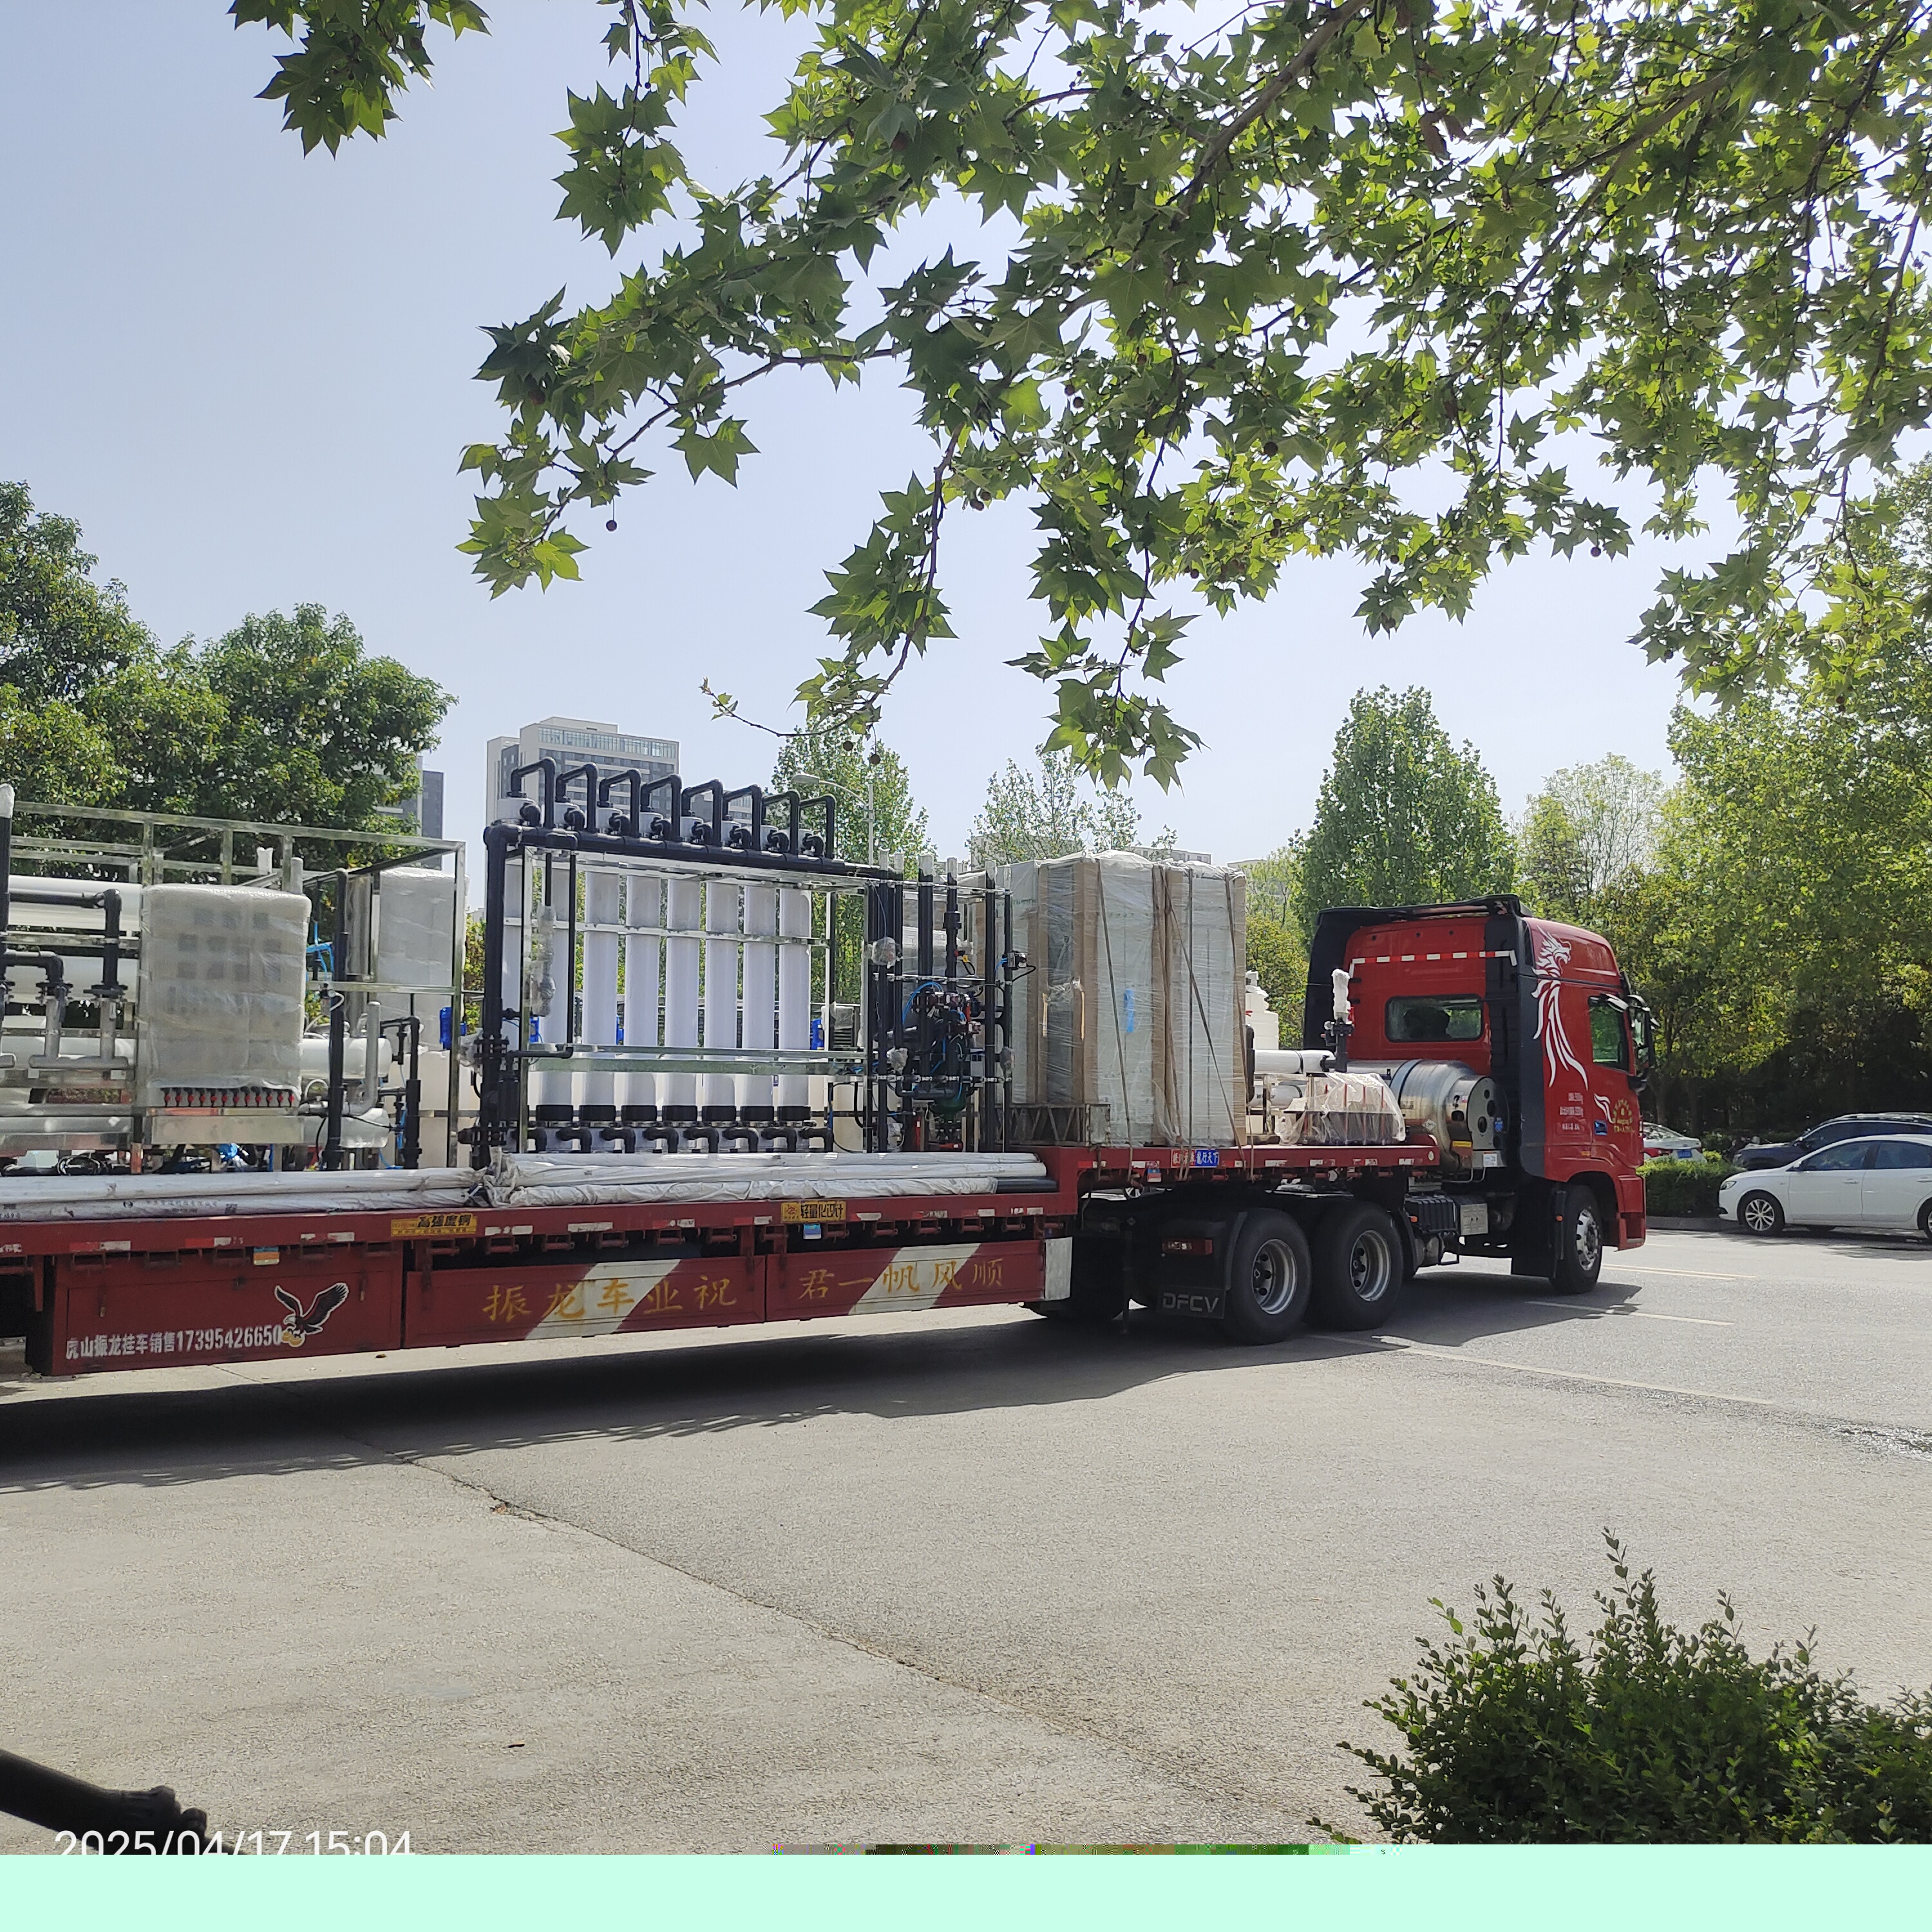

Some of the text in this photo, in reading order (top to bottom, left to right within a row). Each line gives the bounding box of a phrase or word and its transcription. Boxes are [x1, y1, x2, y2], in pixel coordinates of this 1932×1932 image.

[800, 1202, 844, 1220] 轻量化设计
[482, 1258, 1003, 1323] 振龙车业祝 君一帆风顺
[1162, 1292, 1219, 1313] DFCV
